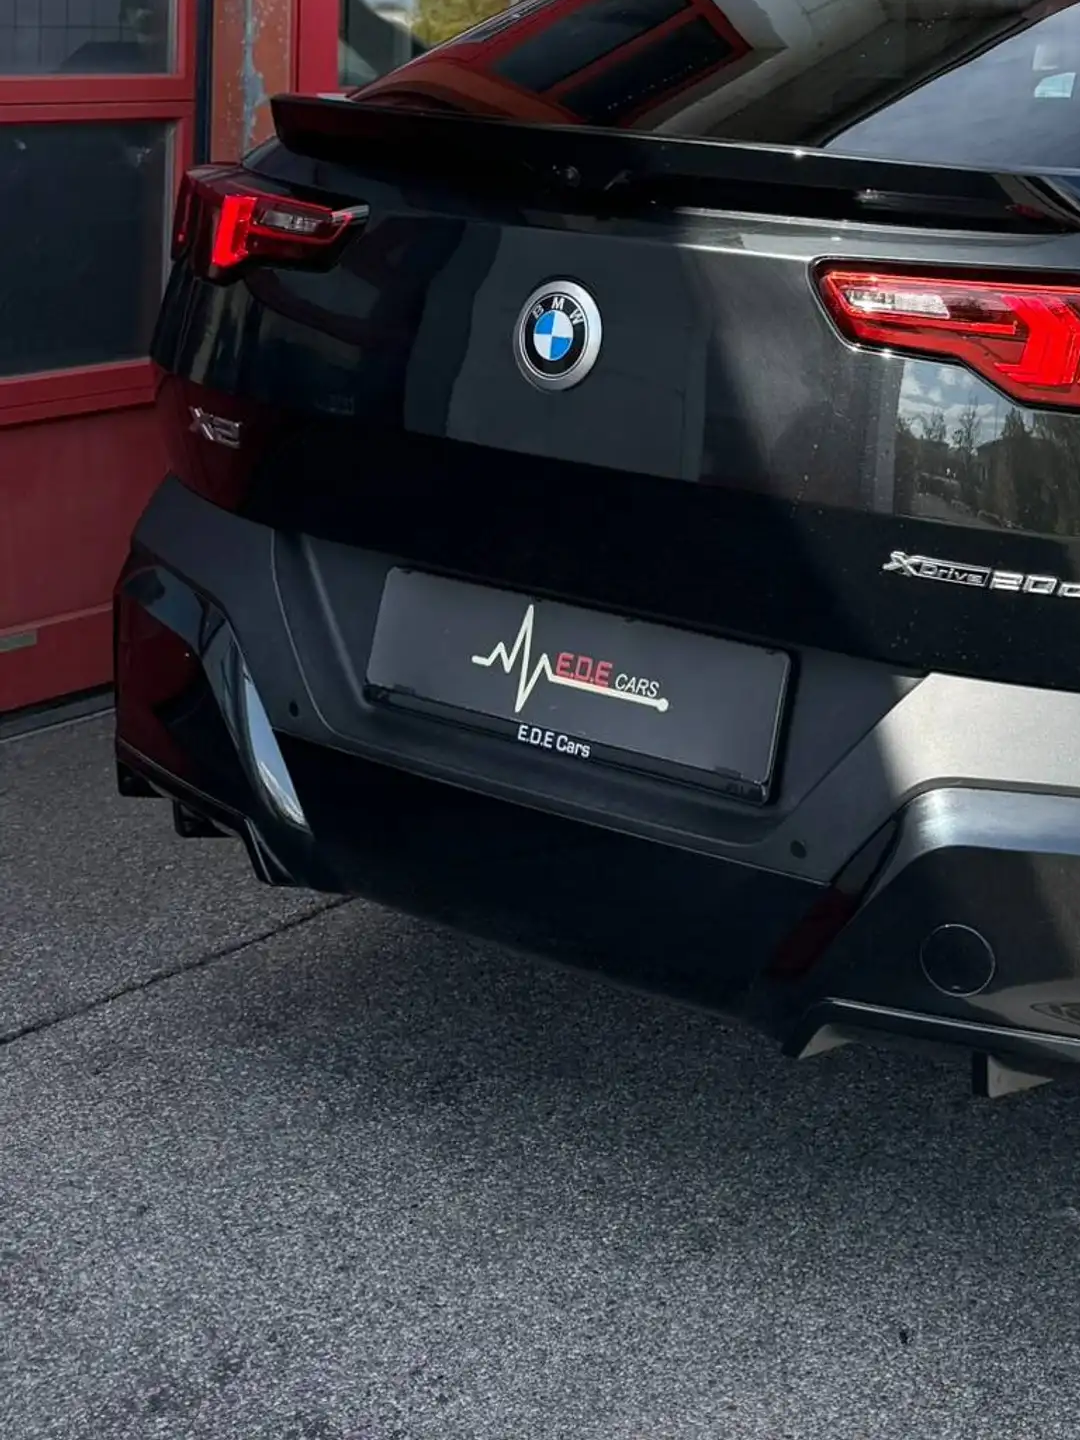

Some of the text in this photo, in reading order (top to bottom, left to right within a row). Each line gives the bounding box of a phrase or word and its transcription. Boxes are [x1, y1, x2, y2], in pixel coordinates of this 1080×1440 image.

[531, 296, 585, 325] BMW
[555, 651, 660, 698] E.D.E CARS
[516, 724, 592, 759] E.D.E Cars
